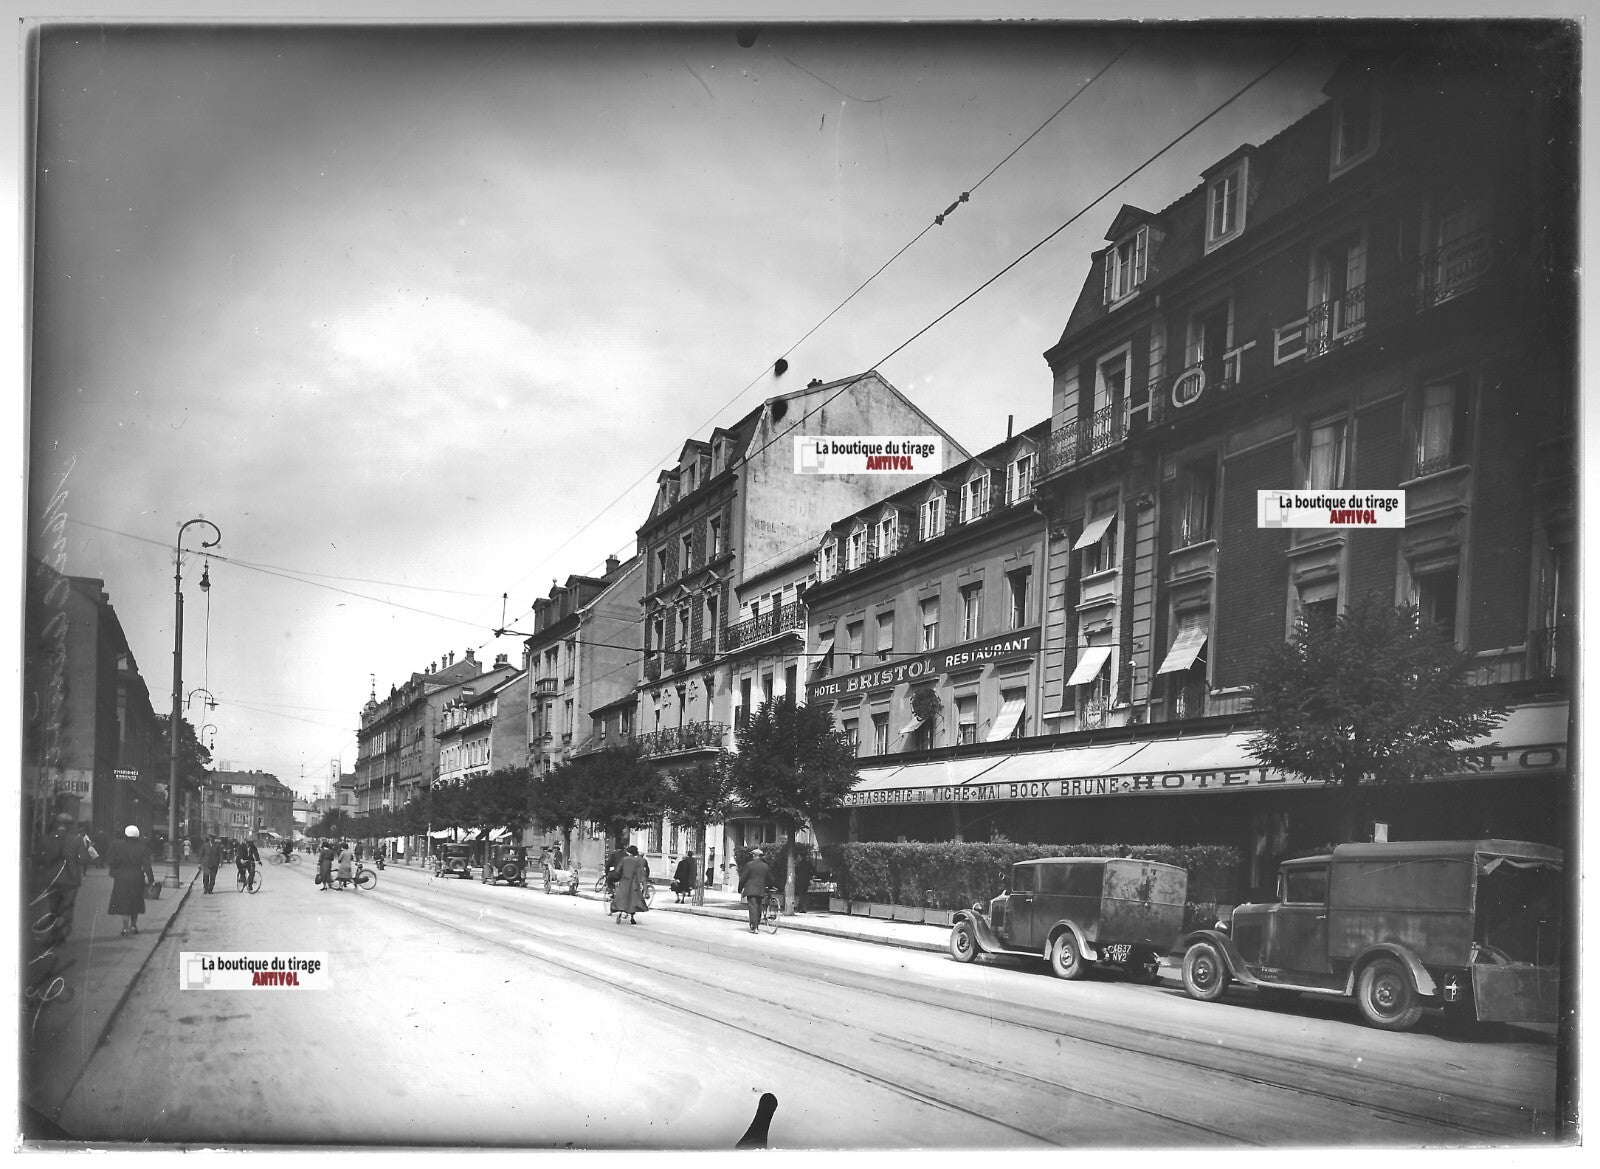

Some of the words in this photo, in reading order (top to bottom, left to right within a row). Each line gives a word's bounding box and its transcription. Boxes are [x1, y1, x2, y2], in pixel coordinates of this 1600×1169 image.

[1126, 300, 1367, 430] HOTEL
[815, 683, 841, 697] HOTEL
[847, 659, 936, 692] BRISTOL
[945, 637, 1031, 667] RESTAURANT
[852, 790, 912, 805] BRASSERIE
[933, 787, 970, 801] TIGRE
[1009, 782, 1050, 798] BOCK
[1060, 777, 1119, 796] BRUNE
[1132, 768, 1287, 790] HOTEL
